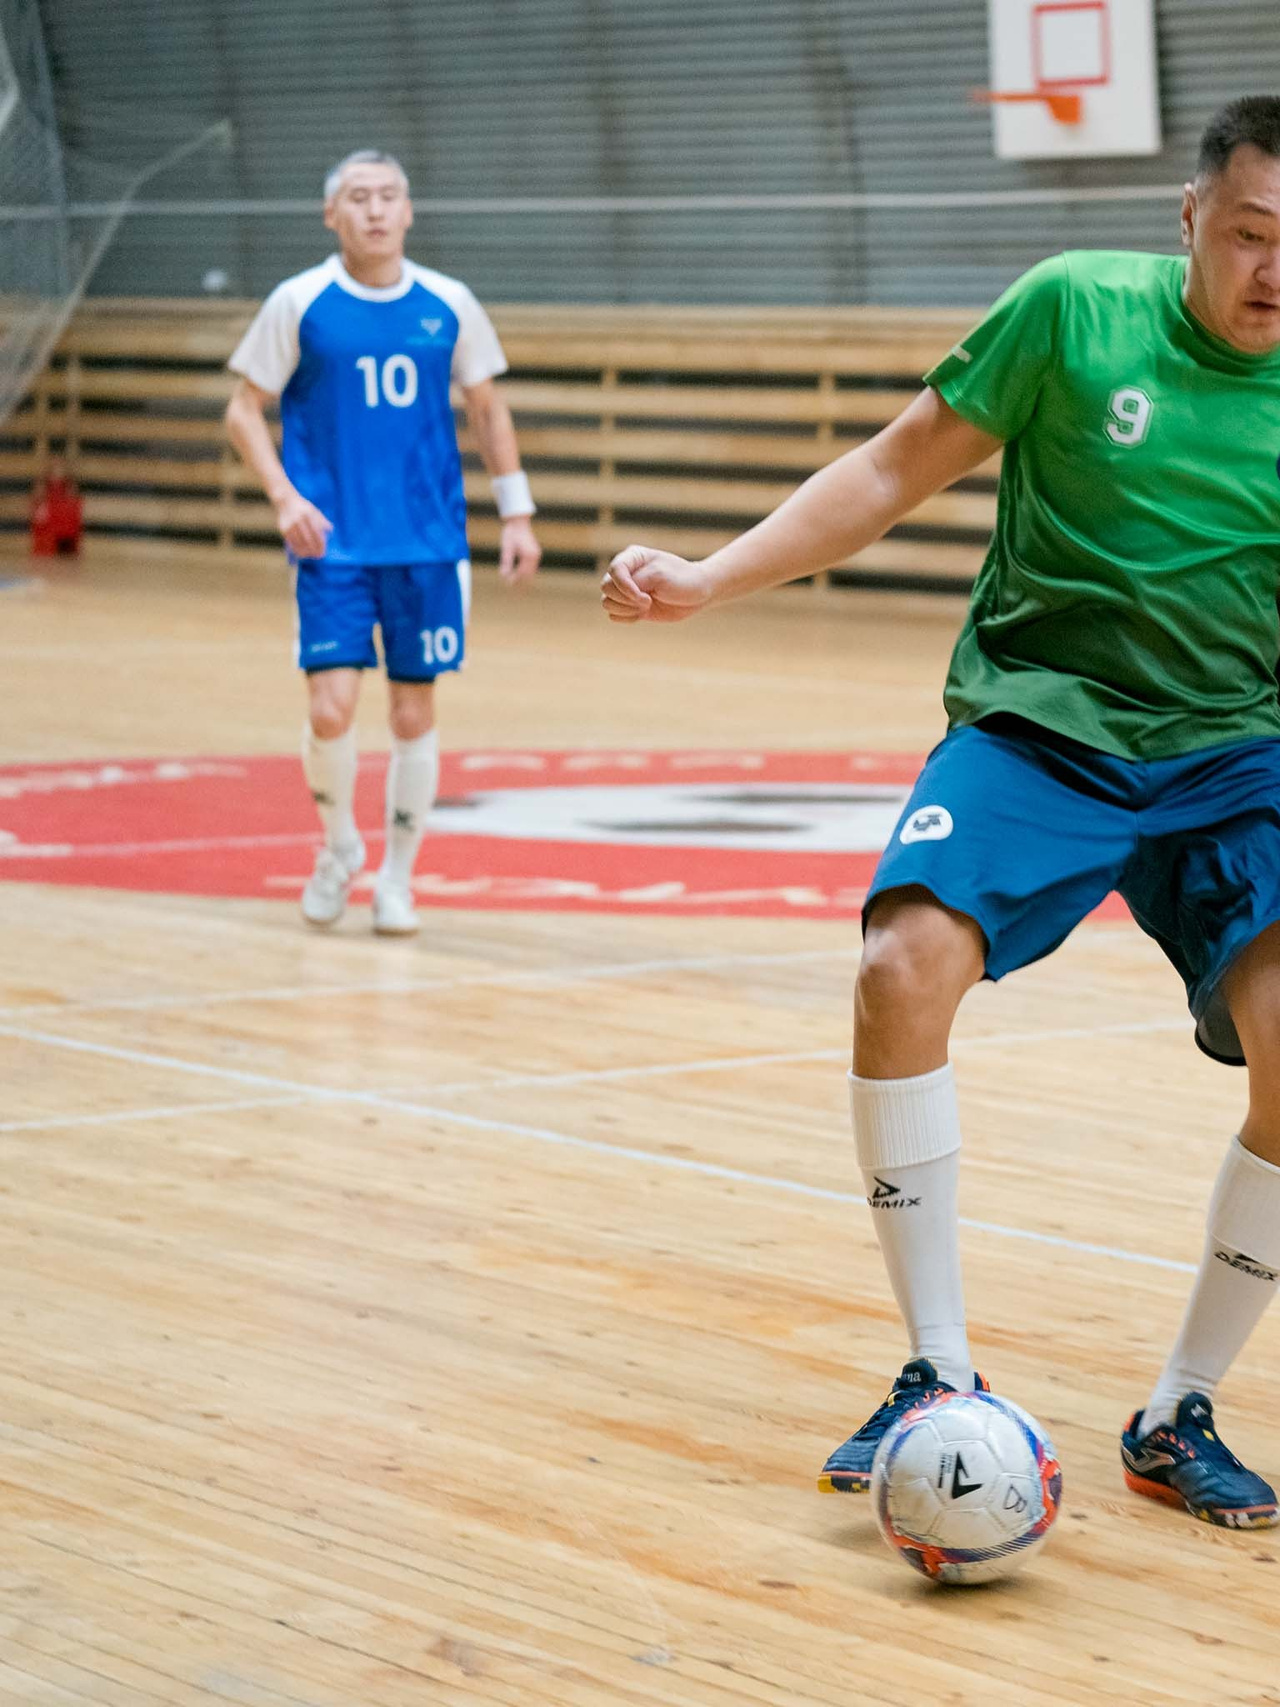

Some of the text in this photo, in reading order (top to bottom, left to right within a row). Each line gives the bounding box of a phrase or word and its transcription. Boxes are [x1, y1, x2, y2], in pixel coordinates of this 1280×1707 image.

[356, 354, 418, 408] 10
[1104, 385, 1153, 448] 9
[420, 626, 458, 665] 10
[1214, 1251, 1279, 1281] DEMIX
